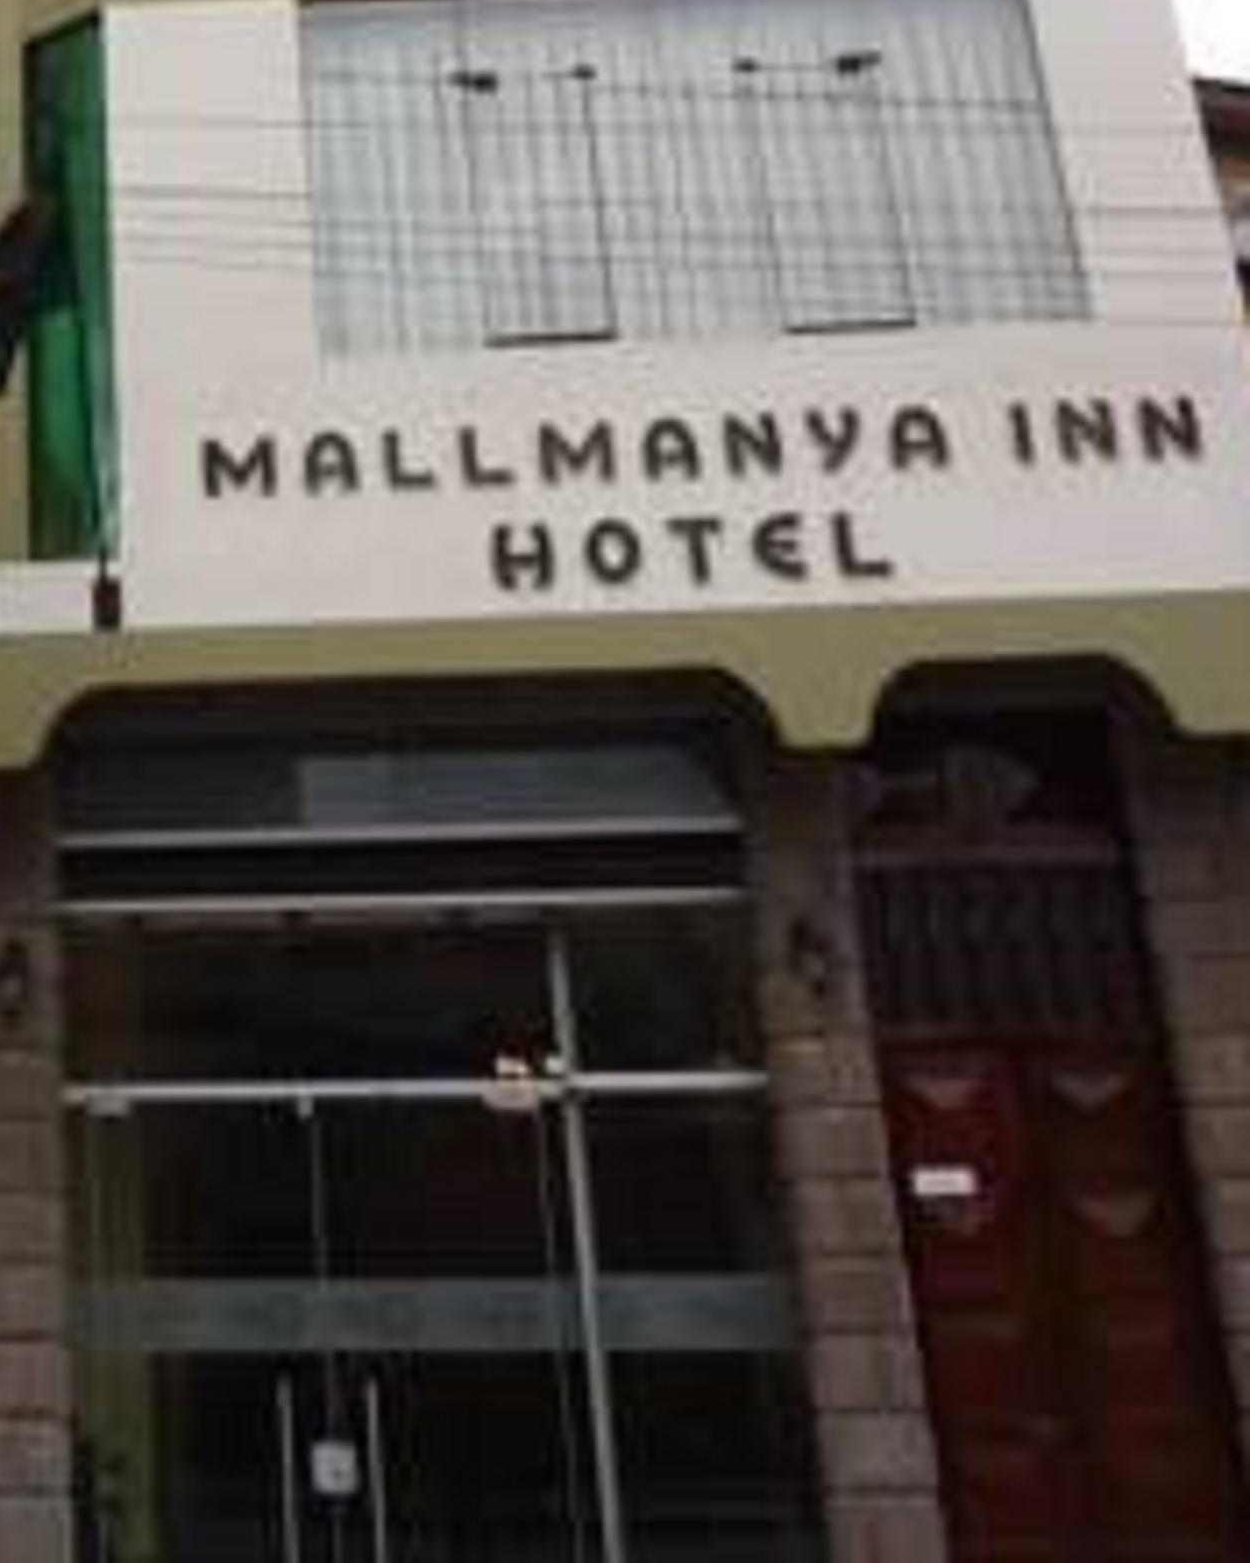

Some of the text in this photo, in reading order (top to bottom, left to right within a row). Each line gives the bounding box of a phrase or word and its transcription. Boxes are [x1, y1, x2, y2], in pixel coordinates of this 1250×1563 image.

[200, 395, 1203, 500] MALLMANYA INN
[489, 511, 894, 592] HOTEL
